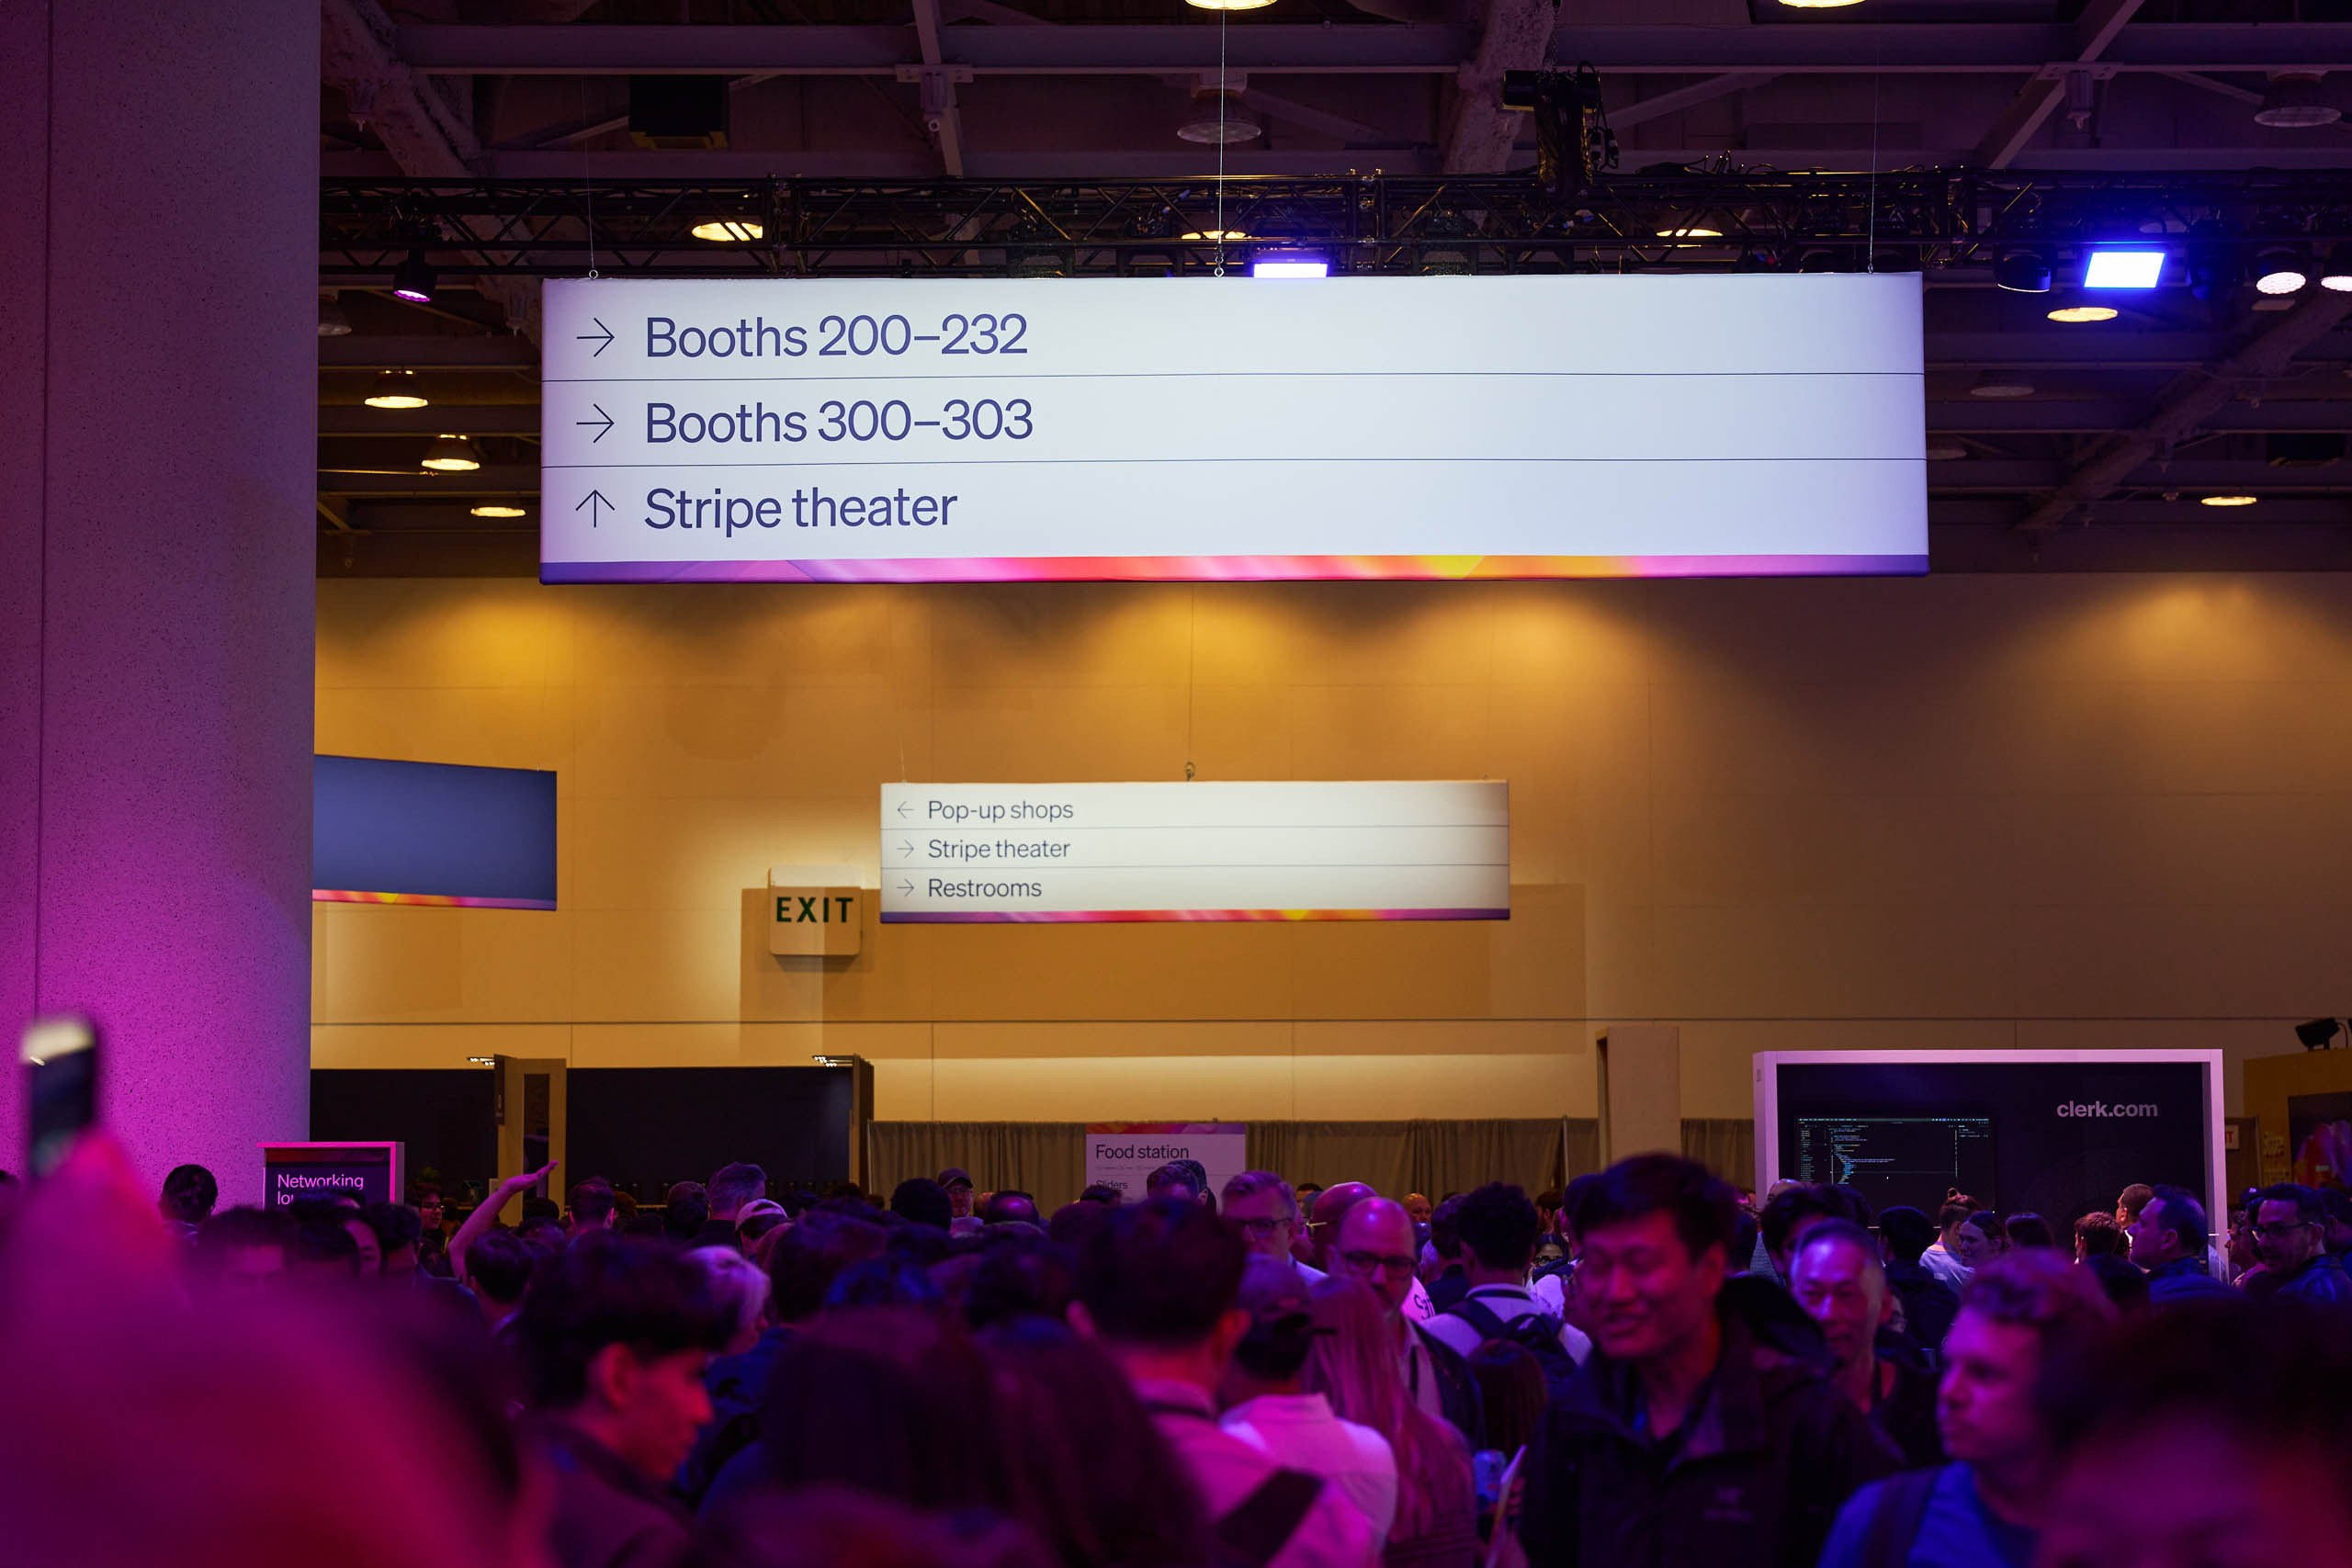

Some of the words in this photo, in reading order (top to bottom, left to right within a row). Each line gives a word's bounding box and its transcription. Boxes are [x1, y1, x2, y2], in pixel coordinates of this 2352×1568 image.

[647, 316, 808, 358] Booths
[819, 312, 1028, 356] 200–232
[647, 401, 808, 444] Booths
[817, 398, 1034, 442] 300–303
[644, 487, 782, 538] Stripe
[791, 486, 958, 528] theater
[928, 800, 1006, 824] Pop-up
[1010, 800, 1074, 823] shops
[927, 839, 991, 863] Stripe
[995, 839, 1071, 859] theater
[928, 877, 1043, 898] Restrooms
[776, 896, 854, 923] EXIT
[2056, 1100, 2159, 1118] clerk.com
[1096, 1144, 1135, 1159] Food
[1137, 1144, 1190, 1159] station
[277, 1173, 364, 1191] Networking
